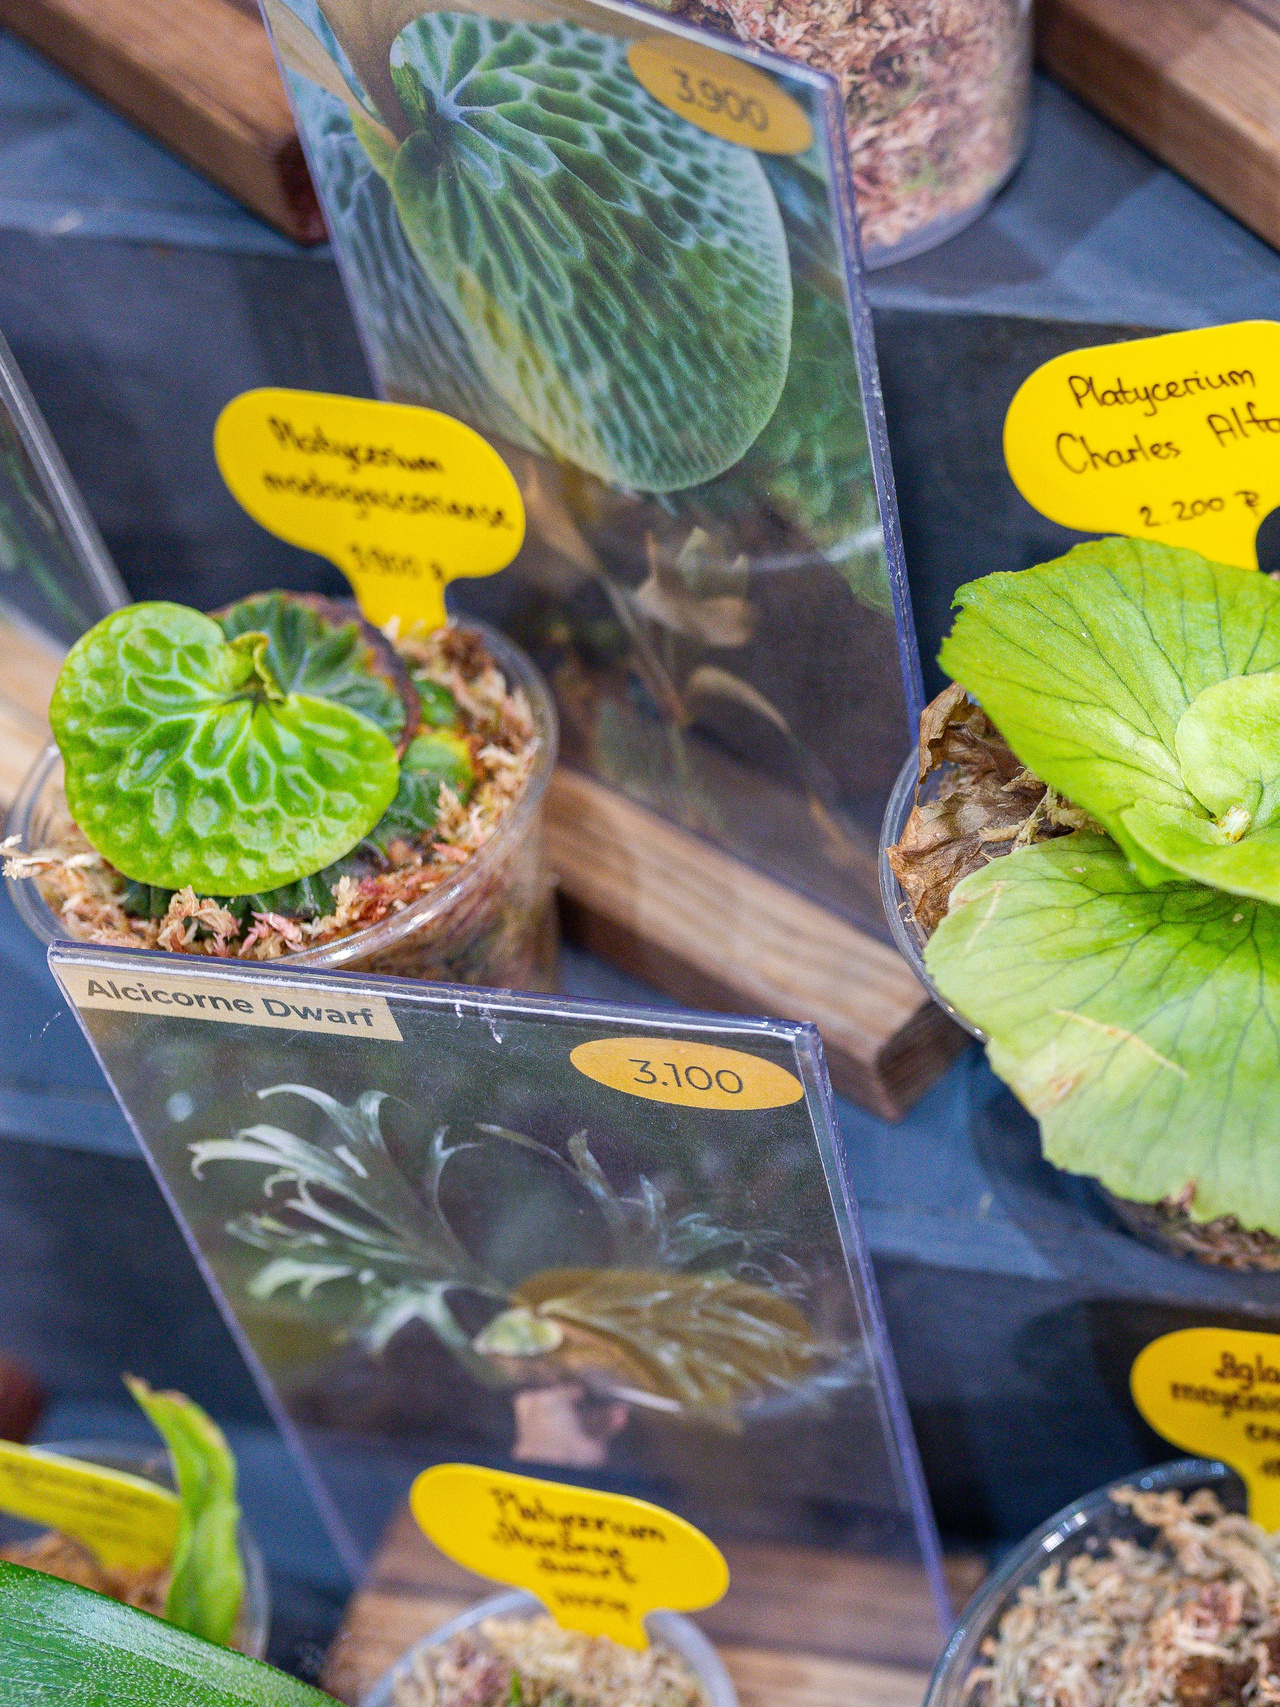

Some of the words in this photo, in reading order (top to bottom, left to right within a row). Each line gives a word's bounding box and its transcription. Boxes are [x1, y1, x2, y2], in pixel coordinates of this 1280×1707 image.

[1068, 369, 1257, 417] Platycerium
[1055, 431, 1181, 474] Charles
[87, 978, 254, 1014] Alcicorne
[261, 997, 375, 1027] Dwarf
[628, 1058, 743, 1094] 3.100
